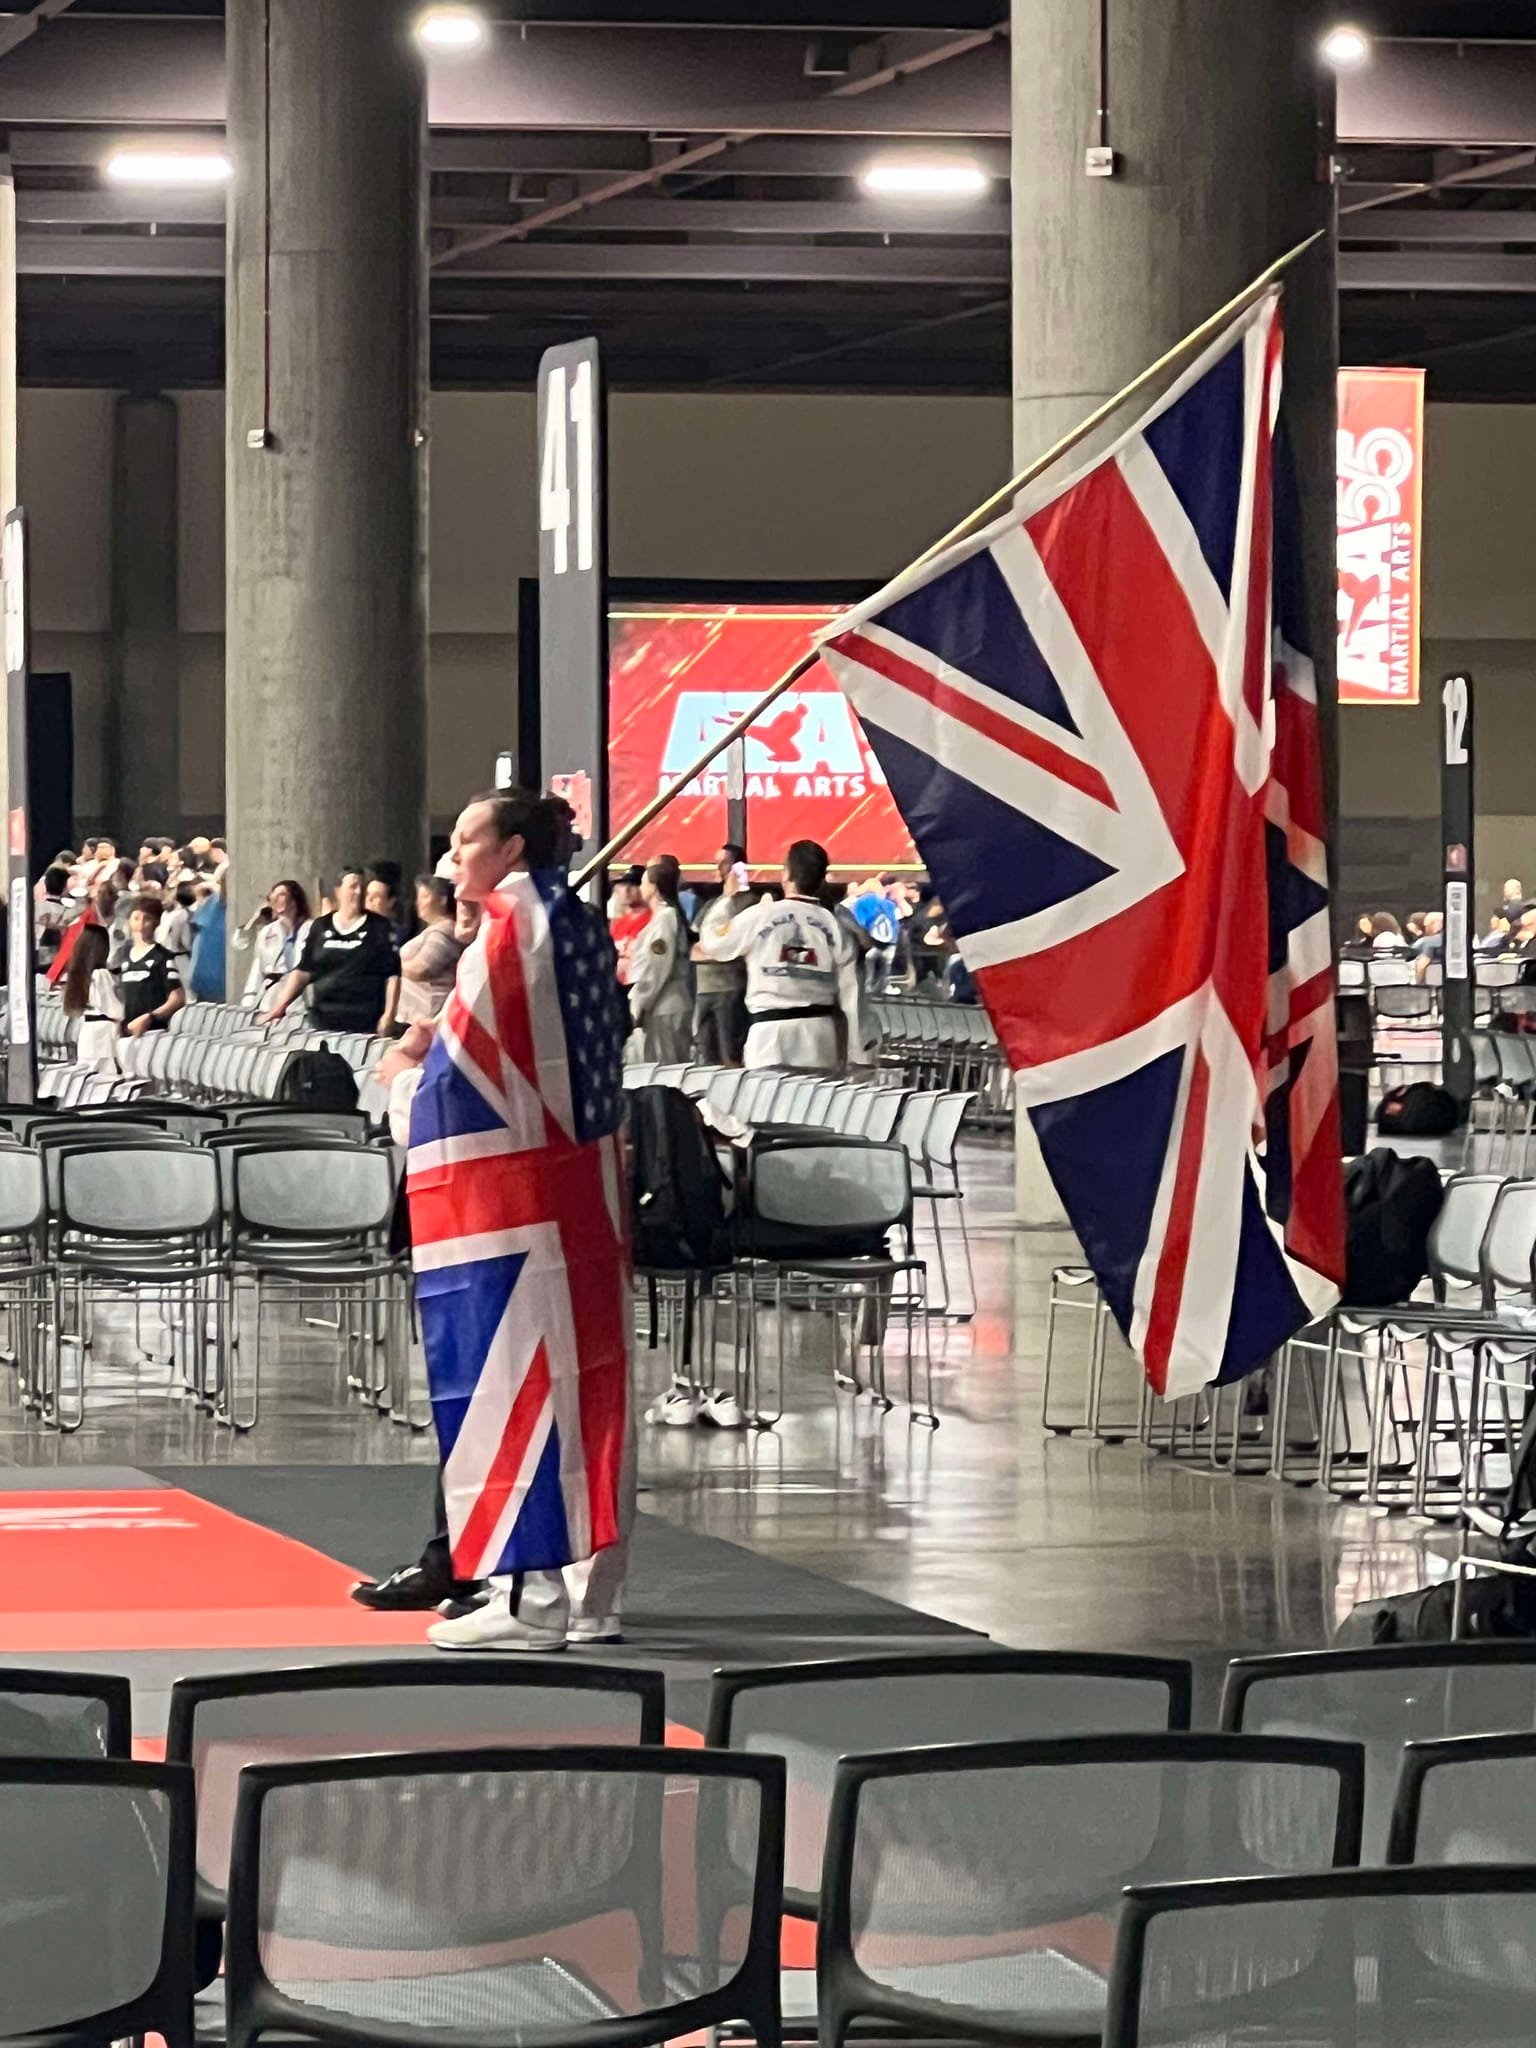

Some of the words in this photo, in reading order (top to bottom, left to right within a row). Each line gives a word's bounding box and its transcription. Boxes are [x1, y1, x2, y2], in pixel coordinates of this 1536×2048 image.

[540, 361, 593, 574] 41
[1391, 522, 1412, 582] ARTS
[1390, 593, 1411, 695] MARTIAL
[658, 775, 781, 798] MARAL
[793, 776, 867, 798] ARTS
